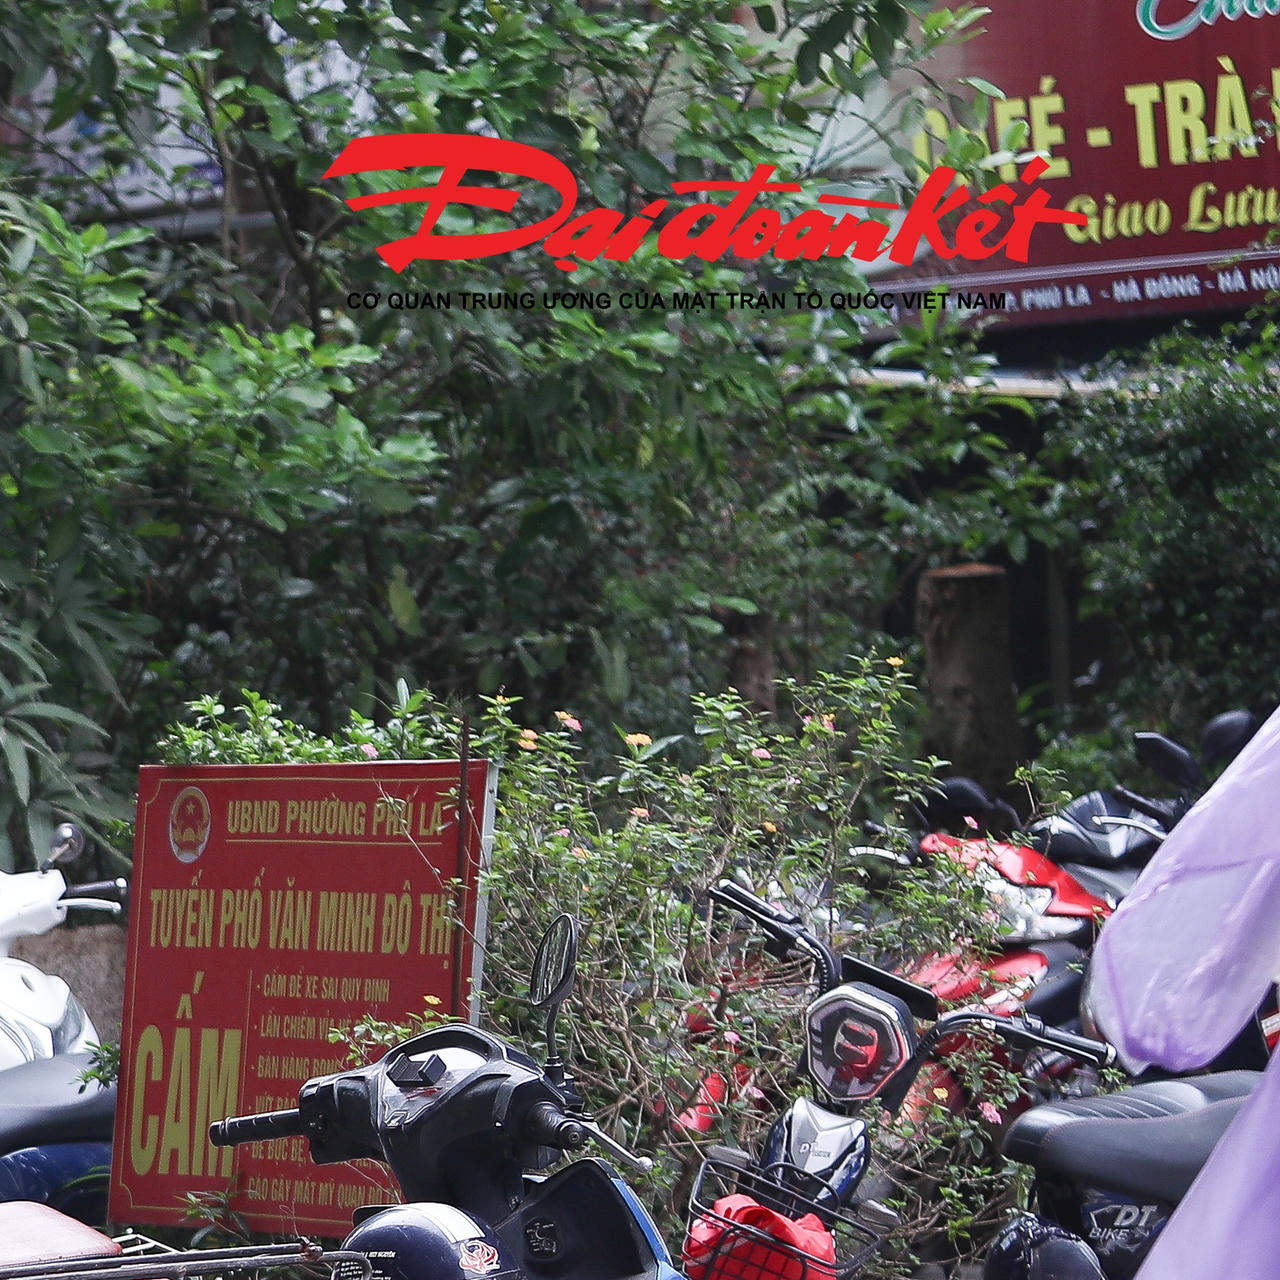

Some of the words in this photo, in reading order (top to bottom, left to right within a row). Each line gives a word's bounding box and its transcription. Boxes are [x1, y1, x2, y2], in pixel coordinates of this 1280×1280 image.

[1125, 55, 1260, 168] TRÀ
[1063, 192, 1172, 244] Giao
[227, 800, 280, 834] UBND
[286, 792, 368, 836] PHƯỜNG
[150, 869, 215, 948] TUYẾN
[219, 866, 266, 949] PHỐ
[269, 877, 313, 950] VĂN
[316, 890, 377, 952] MINH
[381, 879, 413, 955] ĐÔ
[305, 975, 318, 998] XE
[321, 976, 339, 1000] SAI
[341, 977, 362, 1002] QUY
[131, 971, 242, 1178] CẤM
[1114, 1205, 1158, 1226] DT
